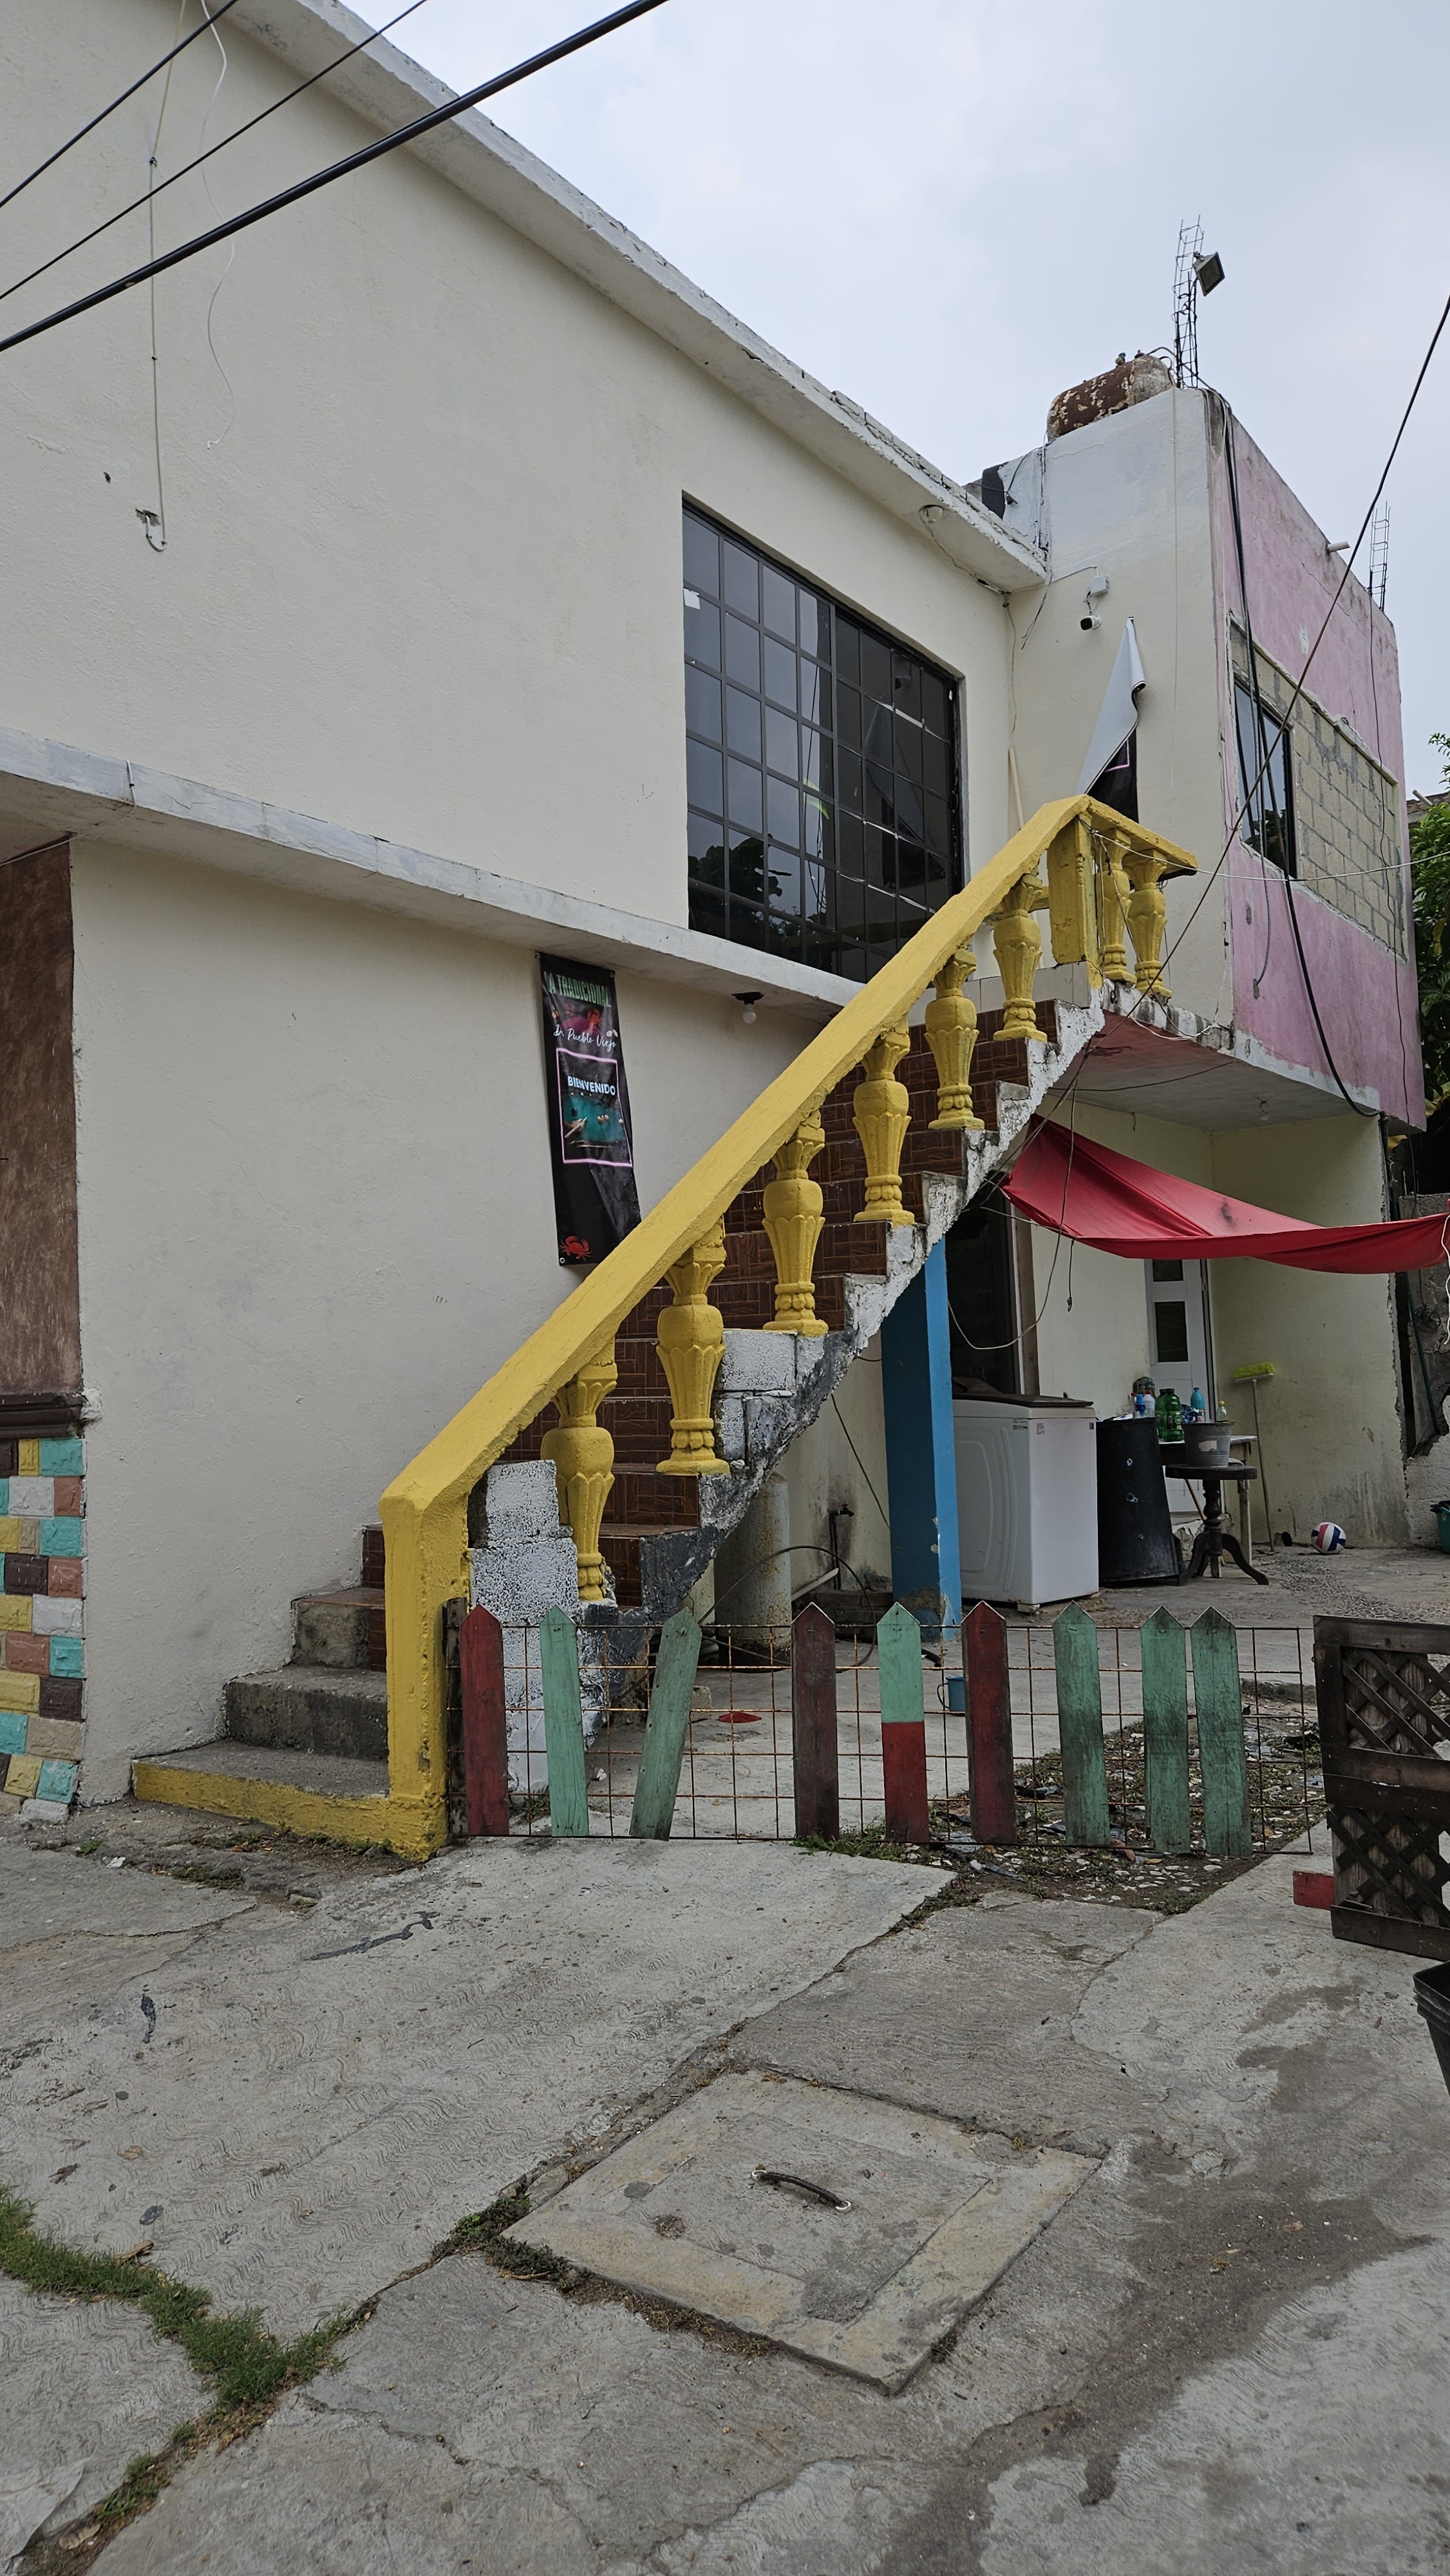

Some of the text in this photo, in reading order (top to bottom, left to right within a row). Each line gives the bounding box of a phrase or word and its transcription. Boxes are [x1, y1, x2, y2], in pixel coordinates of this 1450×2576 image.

[556, 974, 611, 1008] TRADICIONAL
[567, 1028, 594, 1043] Pueblo
[596, 1035, 617, 1052] Viejo
[568, 1075, 616, 1095] BIENVENIDO
